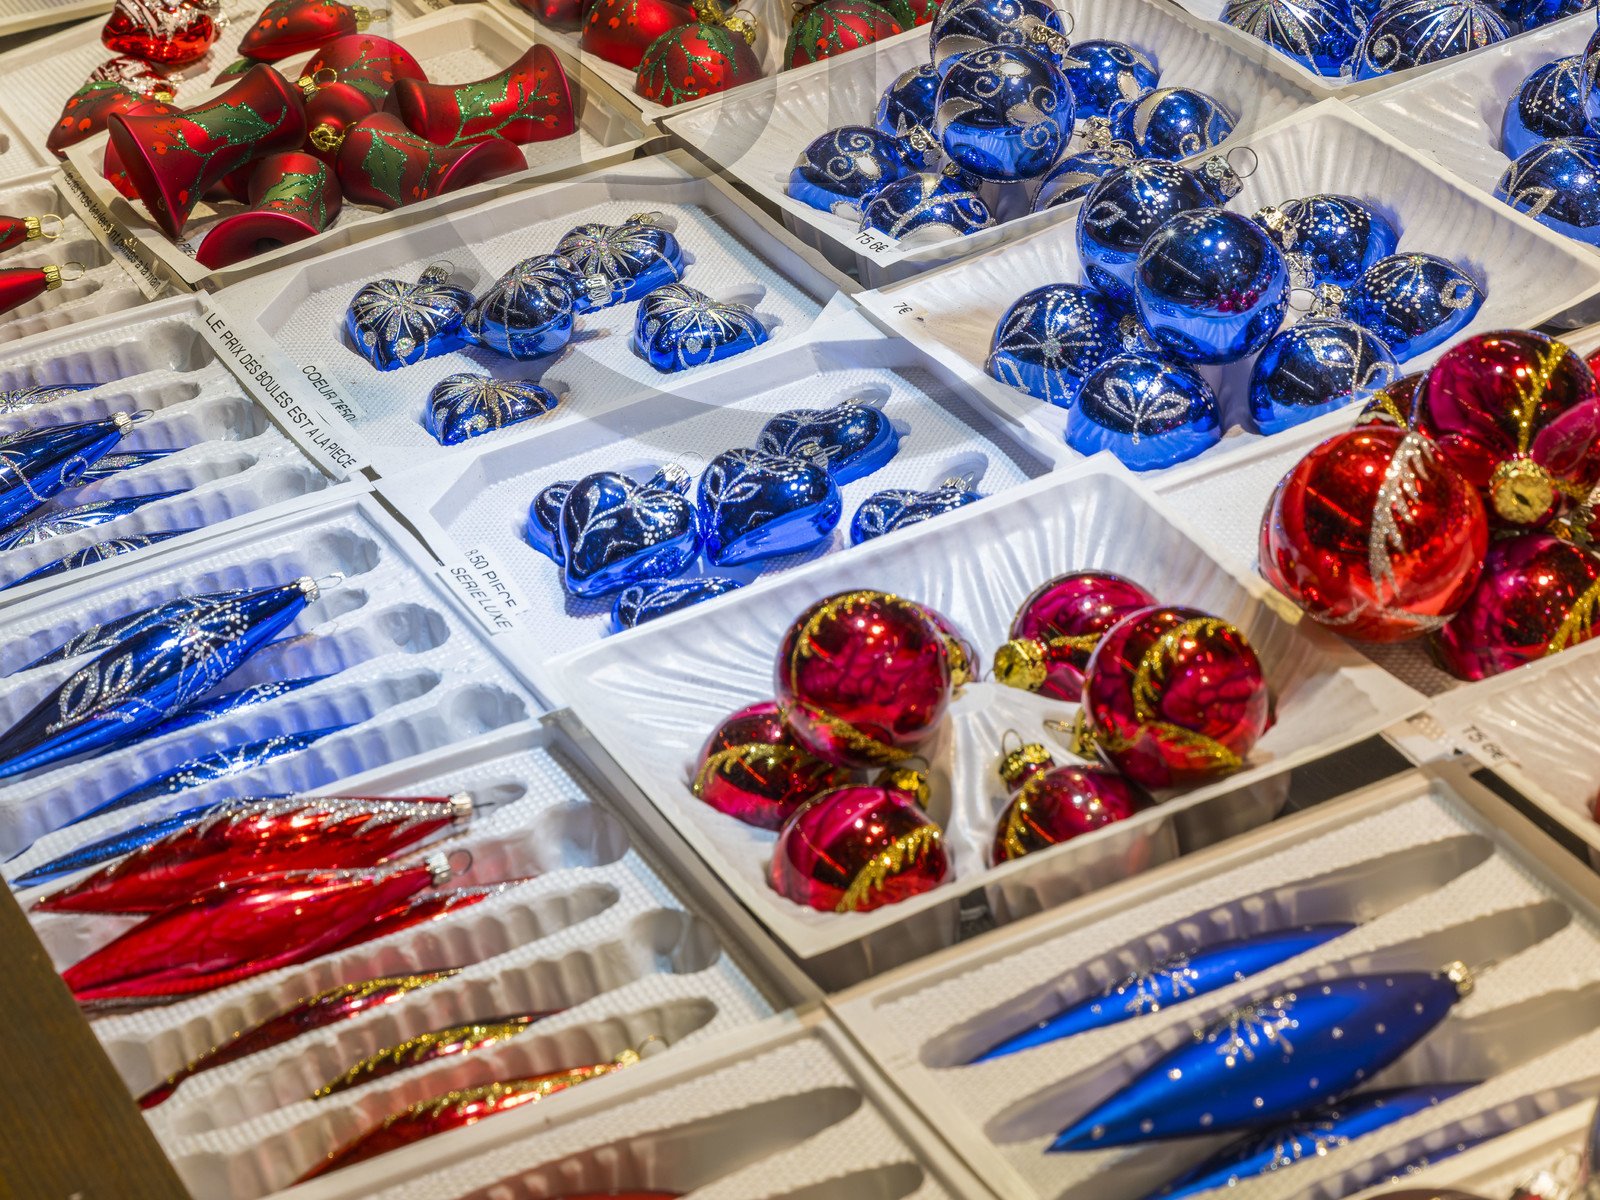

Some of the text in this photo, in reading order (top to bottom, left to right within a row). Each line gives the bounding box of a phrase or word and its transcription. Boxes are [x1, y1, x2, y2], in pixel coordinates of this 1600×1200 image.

[77, 191, 92, 208] nos
[893, 302, 913, 315] 7€
[205, 312, 357, 469] LE PRIX DES BOULES EST A LA PIECE
[302, 365, 338, 400] COEUR
[450, 567, 514, 628] SERIE LUXE
